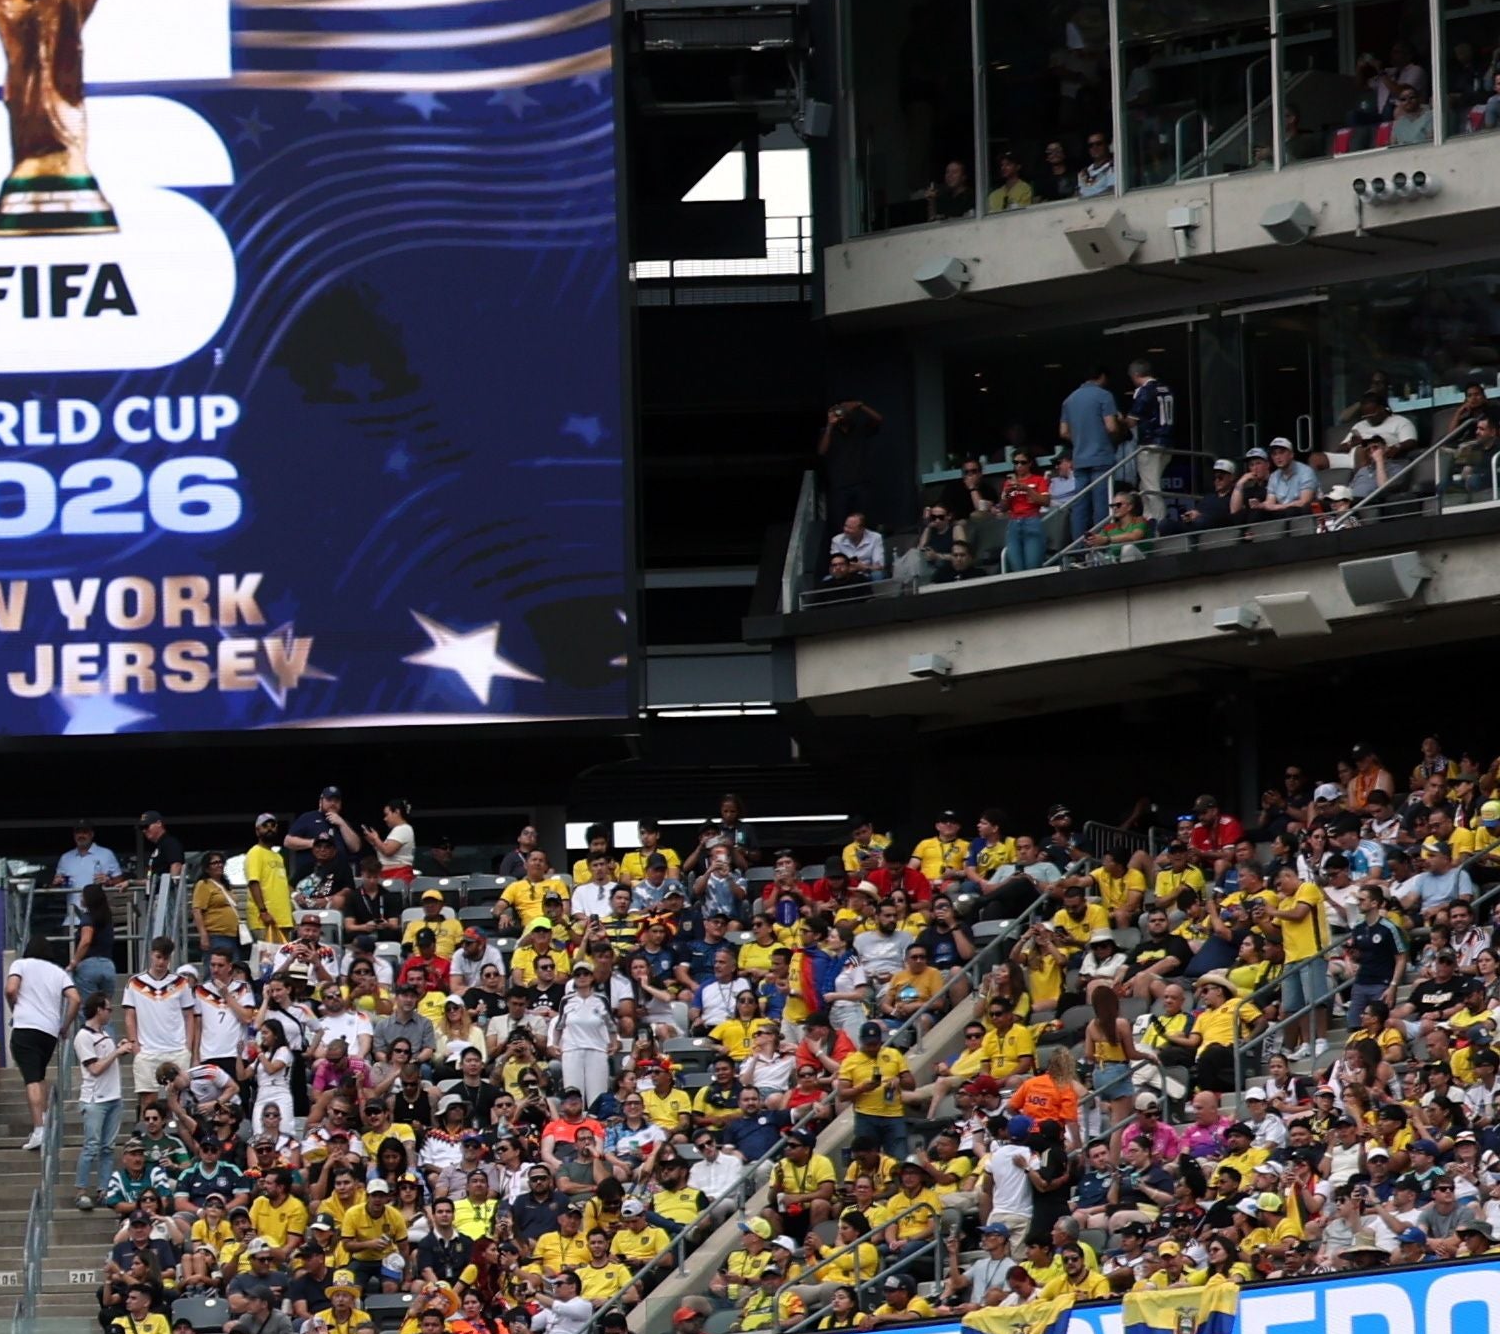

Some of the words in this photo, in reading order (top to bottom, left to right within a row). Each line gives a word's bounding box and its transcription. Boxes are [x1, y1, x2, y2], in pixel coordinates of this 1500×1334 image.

[112, 395, 240, 444] CUP
[1157, 396, 1175, 427] 10
[52, 572, 267, 631] YORK
[7, 637, 315, 698] JERSEY
[217, 1012, 227, 1025] 7
[71, 1271, 93, 1284] 207
